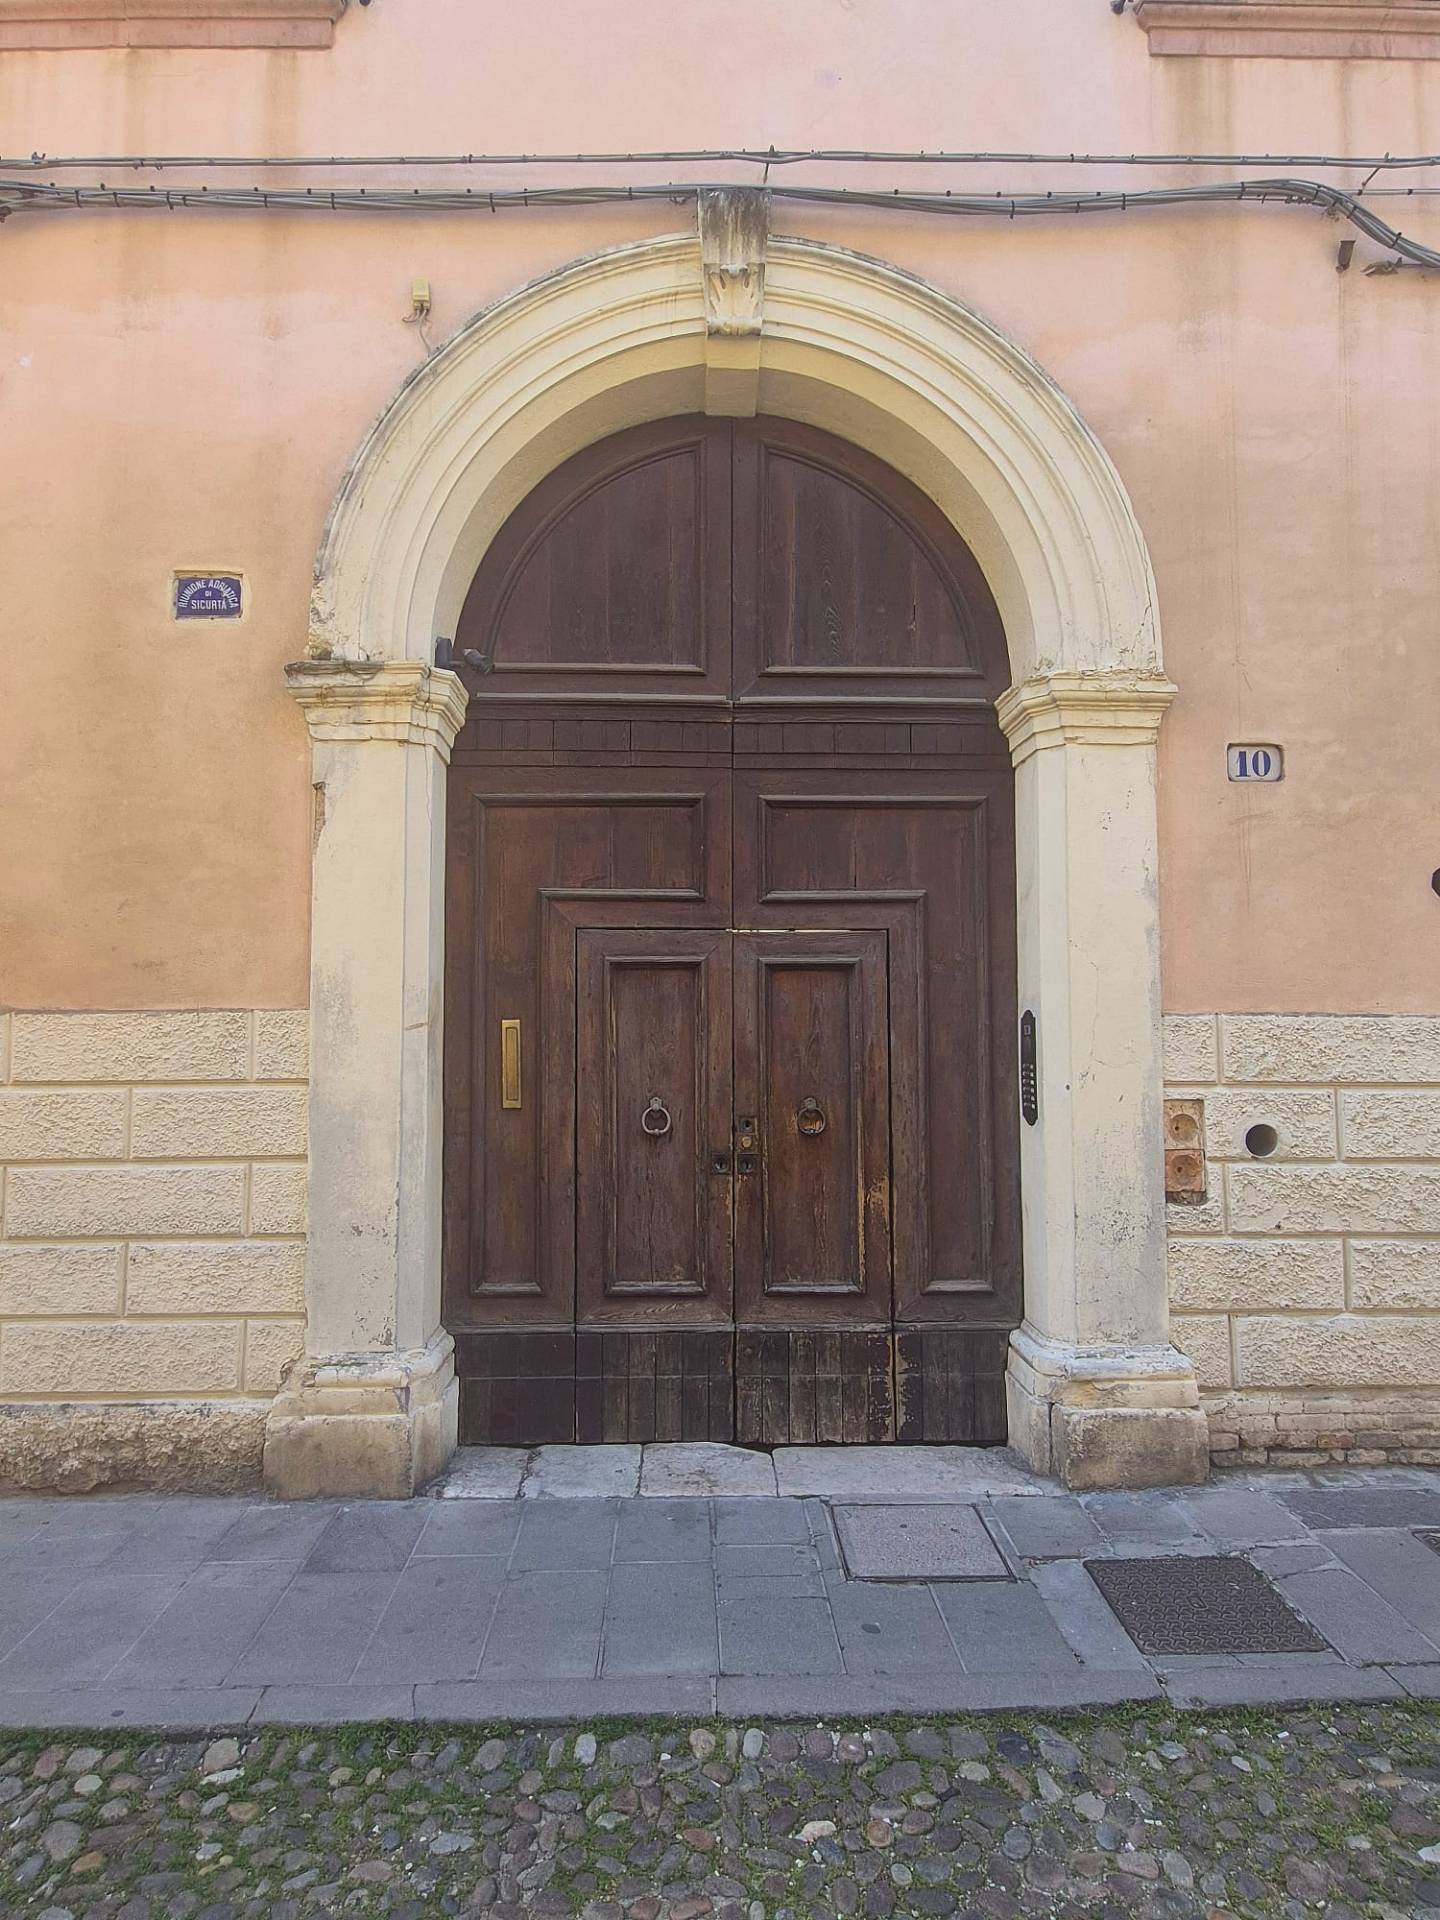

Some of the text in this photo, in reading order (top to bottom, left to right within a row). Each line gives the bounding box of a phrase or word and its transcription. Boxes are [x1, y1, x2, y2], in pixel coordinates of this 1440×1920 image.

[178, 580, 239, 608] RIUNIONE ADRIATICA
[1235, 750, 1271, 777] 10
